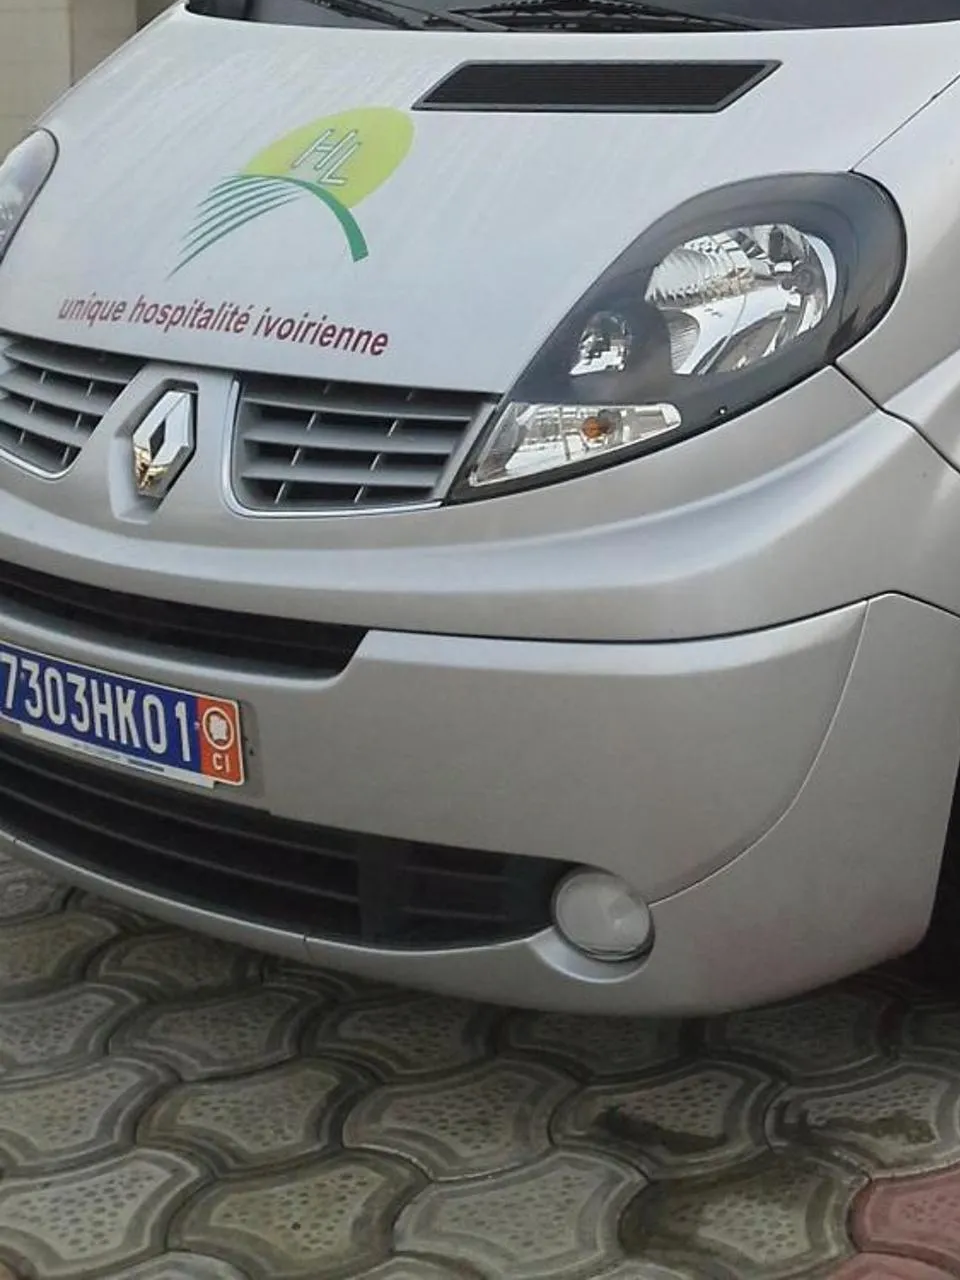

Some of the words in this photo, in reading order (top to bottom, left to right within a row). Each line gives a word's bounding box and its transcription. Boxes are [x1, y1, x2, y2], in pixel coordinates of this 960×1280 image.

[290, 128, 362, 186] HL
[57, 291, 128, 332] unique
[127, 293, 254, 335] hospitalité
[252, 307, 389, 357] ivoirienne
[212, 752, 230, 773] CI
